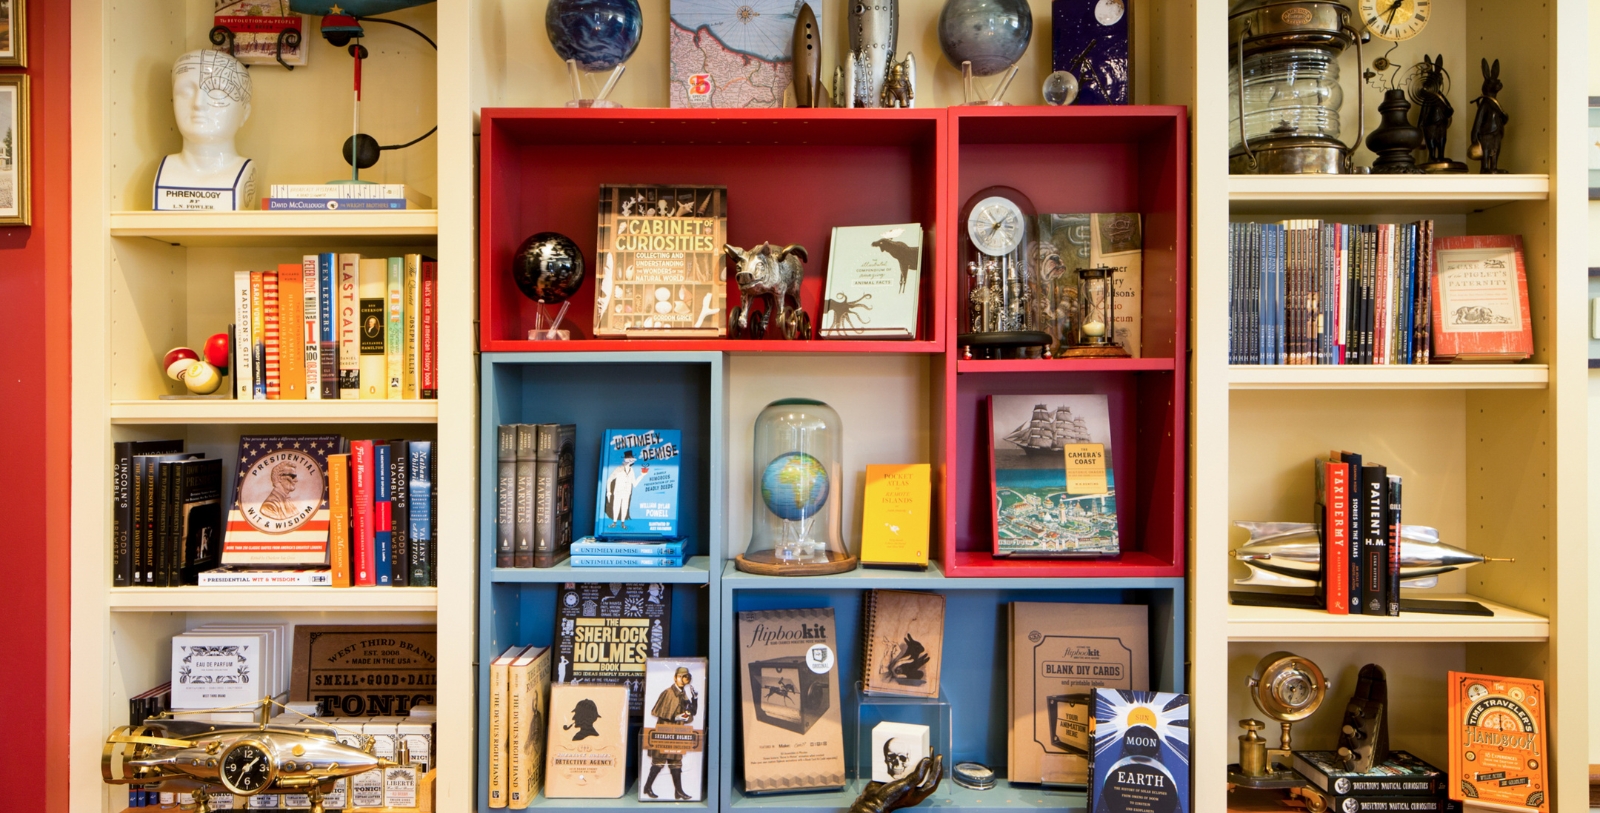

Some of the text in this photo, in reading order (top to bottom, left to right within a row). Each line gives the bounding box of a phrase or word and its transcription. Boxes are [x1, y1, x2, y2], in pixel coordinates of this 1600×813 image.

[166, 191, 221, 199] PHRENOLOGY
[271, 200, 287, 209] DAVID
[629, 220, 703, 235] CABINET
[615, 236, 713, 250] CURIOSITIES
[305, 260, 315, 276] PETER
[343, 263, 353, 347] LAST CALL
[306, 352, 317, 360] 100
[307, 362, 317, 384] OBJECTS
[614, 432, 661, 450] UNTIMELY
[355, 446, 364, 464] First
[643, 445, 678, 461] DEMISE
[252, 454, 316, 476] PRESIDENTIAL
[1334, 469, 1344, 546] TAXIDERMY
[1370, 482, 1380, 536] PATIENT
[248, 507, 262, 523] WIT
[275, 506, 313, 529] WISDOM
[575, 627, 649, 642] SHERLOCK
[747, 623, 826, 648] flipbookit
[328, 638, 436, 664] WEST THIRD BRAND
[574, 643, 648, 663] HOLMES
[1046, 664, 1120, 676] BLANK DIY CARDS
[315, 674, 437, 686] SMELL GOOD DAIL
[1066, 713, 1078, 721] YOUR
[1470, 700, 1532, 732] TIME TRAVELER'S
[1060, 721, 1086, 733] ANIMATION
[1066, 730, 1078, 738] HERE
[1126, 736, 1157, 747] MOON
[1464, 726, 1540, 757] HANDBOOK
[244, 750, 254, 758] 12
[259, 764, 265, 772] 3
[1118, 771, 1164, 787] EARTH
[1403, 782, 1428, 790] CURIOSITIES
